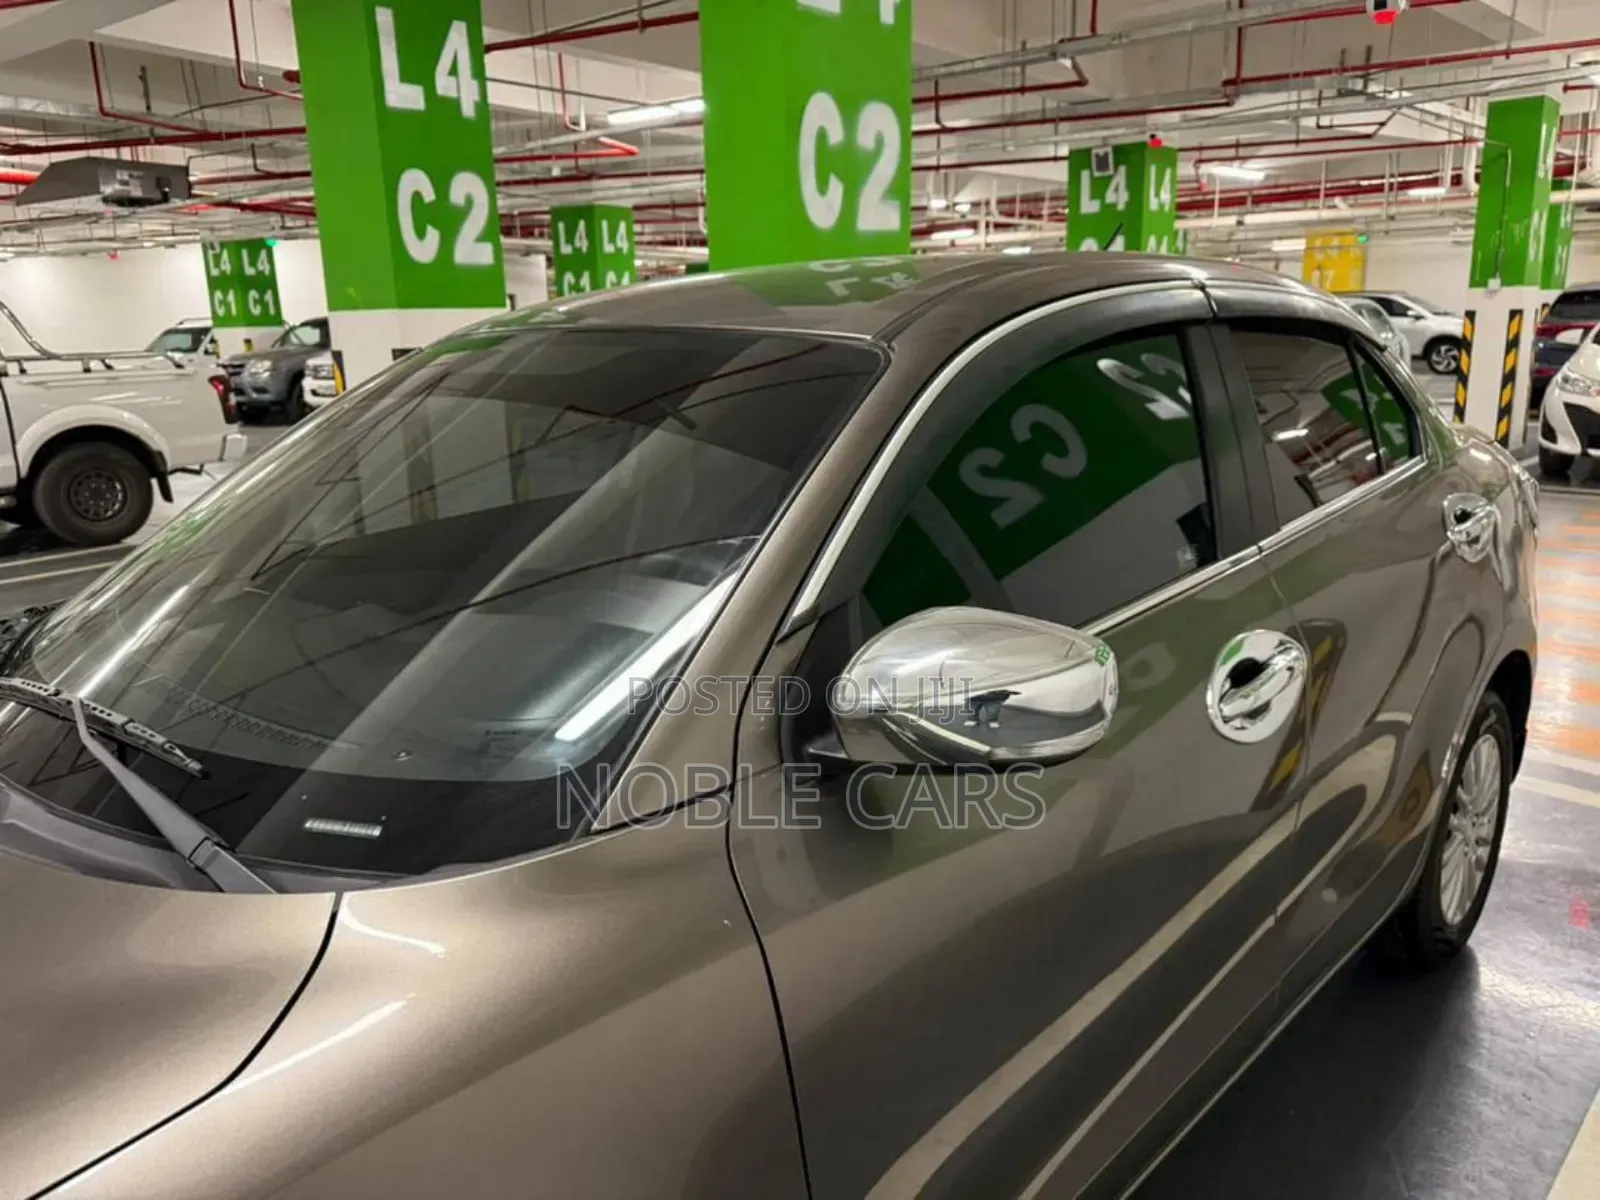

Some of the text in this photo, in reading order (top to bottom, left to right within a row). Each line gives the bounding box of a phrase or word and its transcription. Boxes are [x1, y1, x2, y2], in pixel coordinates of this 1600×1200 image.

[375, 6, 480, 120] L4
[799, 91, 901, 230] C2
[1080, 165, 1130, 214] L4
[1148, 164, 1172, 212] L4
[397, 168, 495, 265] C2
[557, 219, 588, 254] L4
[601, 219, 629, 254] L4
[207, 248, 232, 276] L4
[241, 248, 270, 276] L4
[213, 289, 237, 317] C1
[248, 289, 276, 317] C1
